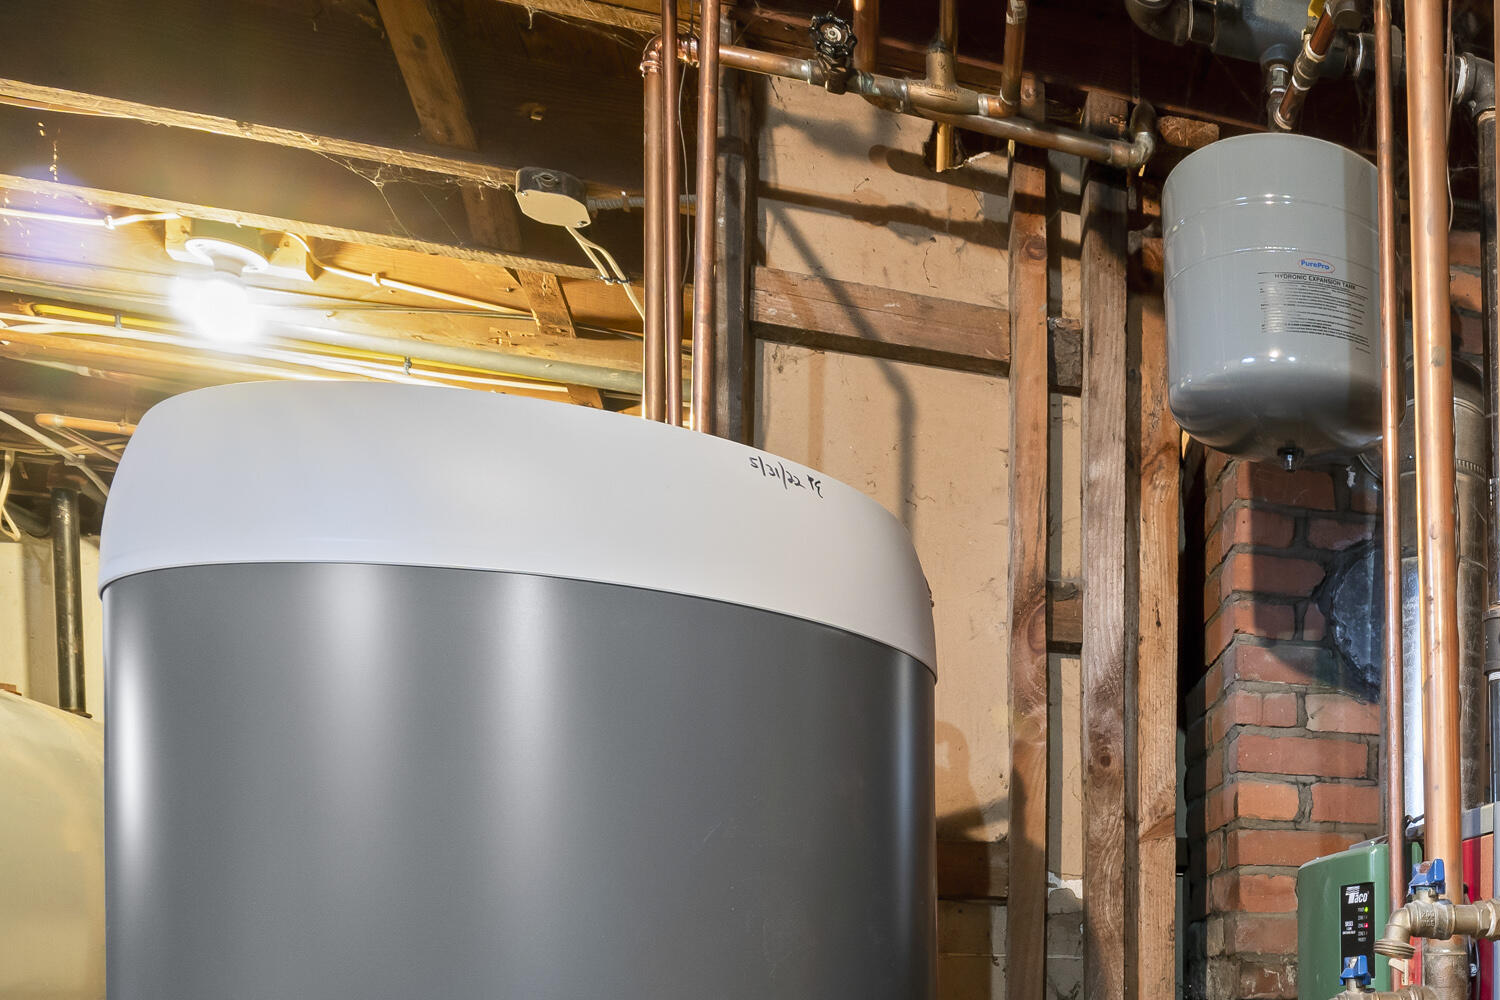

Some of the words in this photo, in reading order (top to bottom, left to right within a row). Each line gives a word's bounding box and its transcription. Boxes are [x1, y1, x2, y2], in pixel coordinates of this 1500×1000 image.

[1300, 259, 1330, 270] PurePro
[1274, 273, 1307, 281] HYDRONIC
[1308, 275, 1341, 286] EXPANSION
[1342, 281, 1356, 290] TANK
